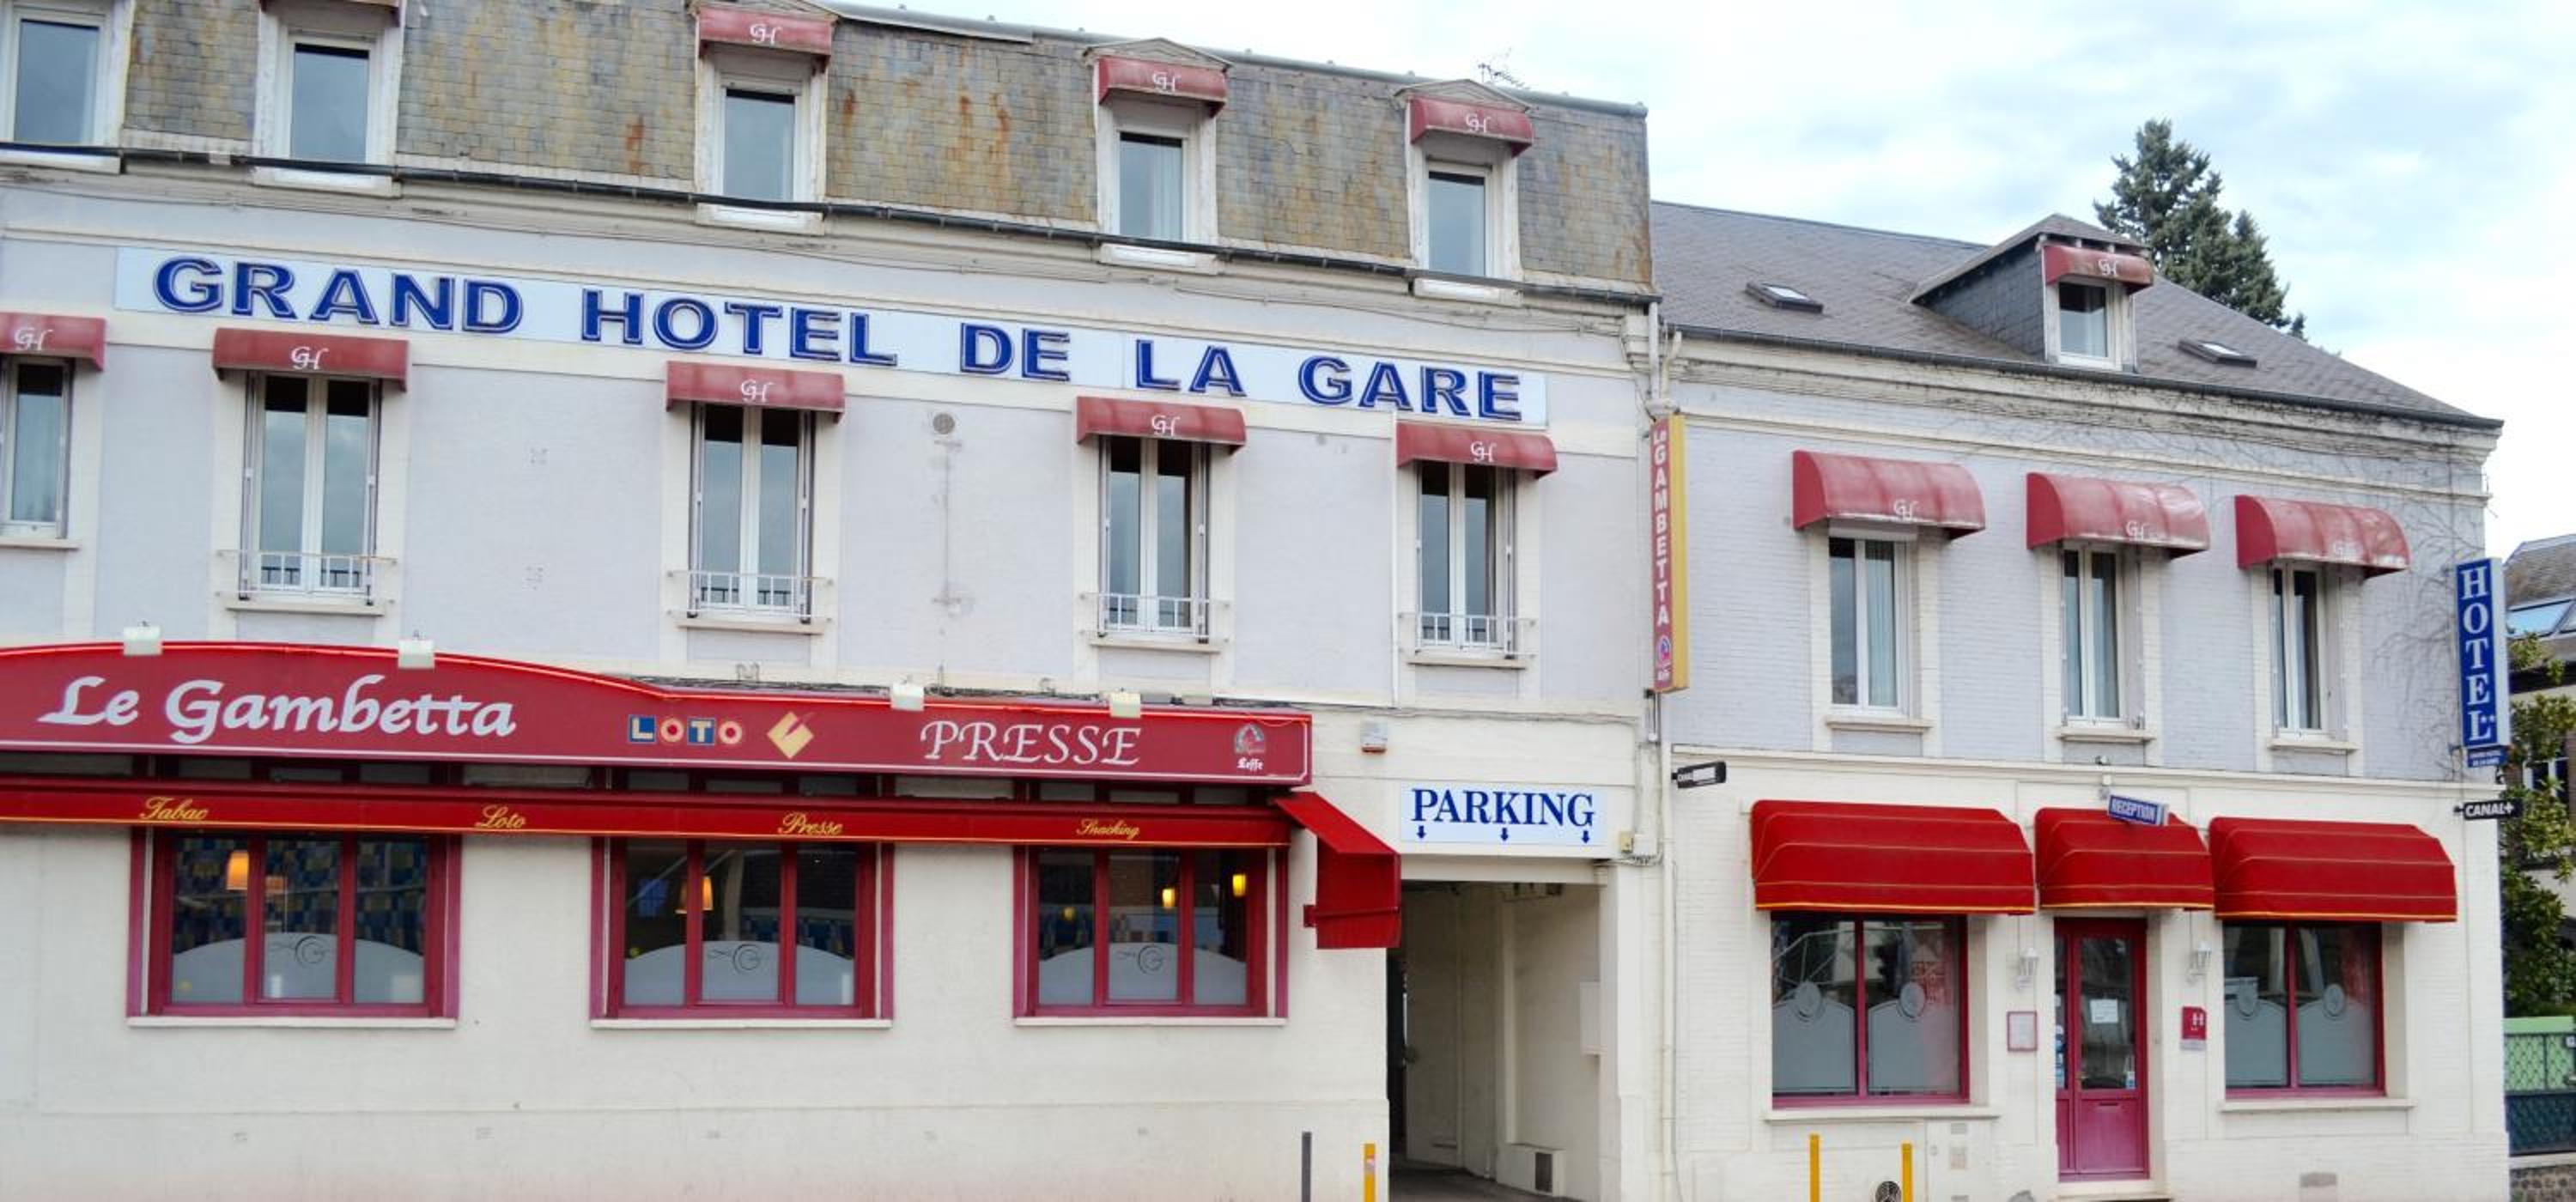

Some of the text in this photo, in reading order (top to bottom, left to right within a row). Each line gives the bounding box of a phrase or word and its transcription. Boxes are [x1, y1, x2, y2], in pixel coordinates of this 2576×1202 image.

[153, 256, 1523, 422] GRAND HOTEL DE LA GARE
[1654, 446, 1669, 626] GAMBETTA
[2461, 566, 2491, 741] HOTEL
[37, 674, 518, 744] Le Gambetta
[628, 713, 744, 747] LOTO
[919, 718, 1141, 767] PRESSE
[139, 796, 210, 823] Tabac
[475, 804, 527, 830] Loto
[777, 811, 844, 837] Presse
[1410, 786, 1595, 828] PARKING
[2110, 797, 2157, 823] RECEPTION
[2465, 801, 2515, 817] CANAL+
[1076, 817, 1140, 841] Snacking
